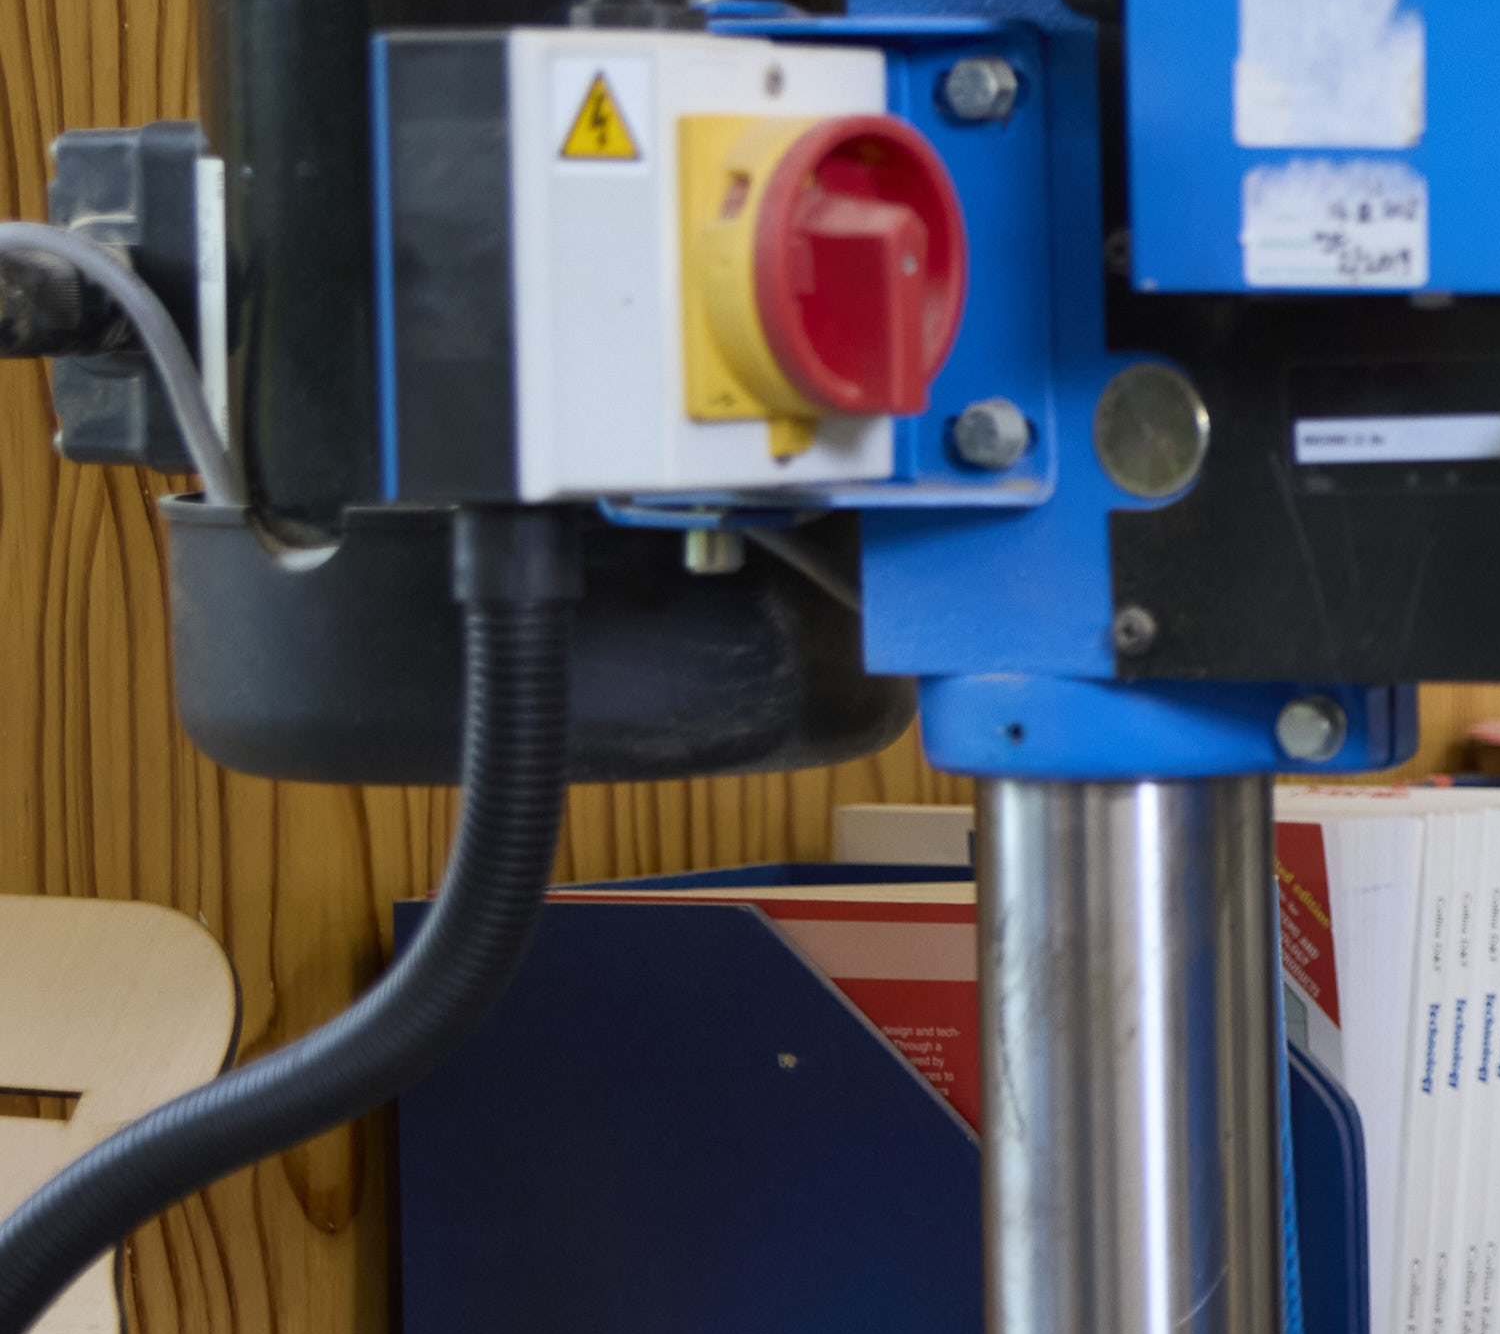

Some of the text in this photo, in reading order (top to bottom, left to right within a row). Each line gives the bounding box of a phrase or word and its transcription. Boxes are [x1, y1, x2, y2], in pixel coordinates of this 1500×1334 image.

[915, 1027, 935, 1036] and
[936, 1026, 961, 1037] tech-
[932, 1056, 945, 1068] by
[1421, 1003, 1441, 1096] Technology
[1448, 999, 1467, 1090] Technology
[1477, 993, 1496, 1085] Technology
